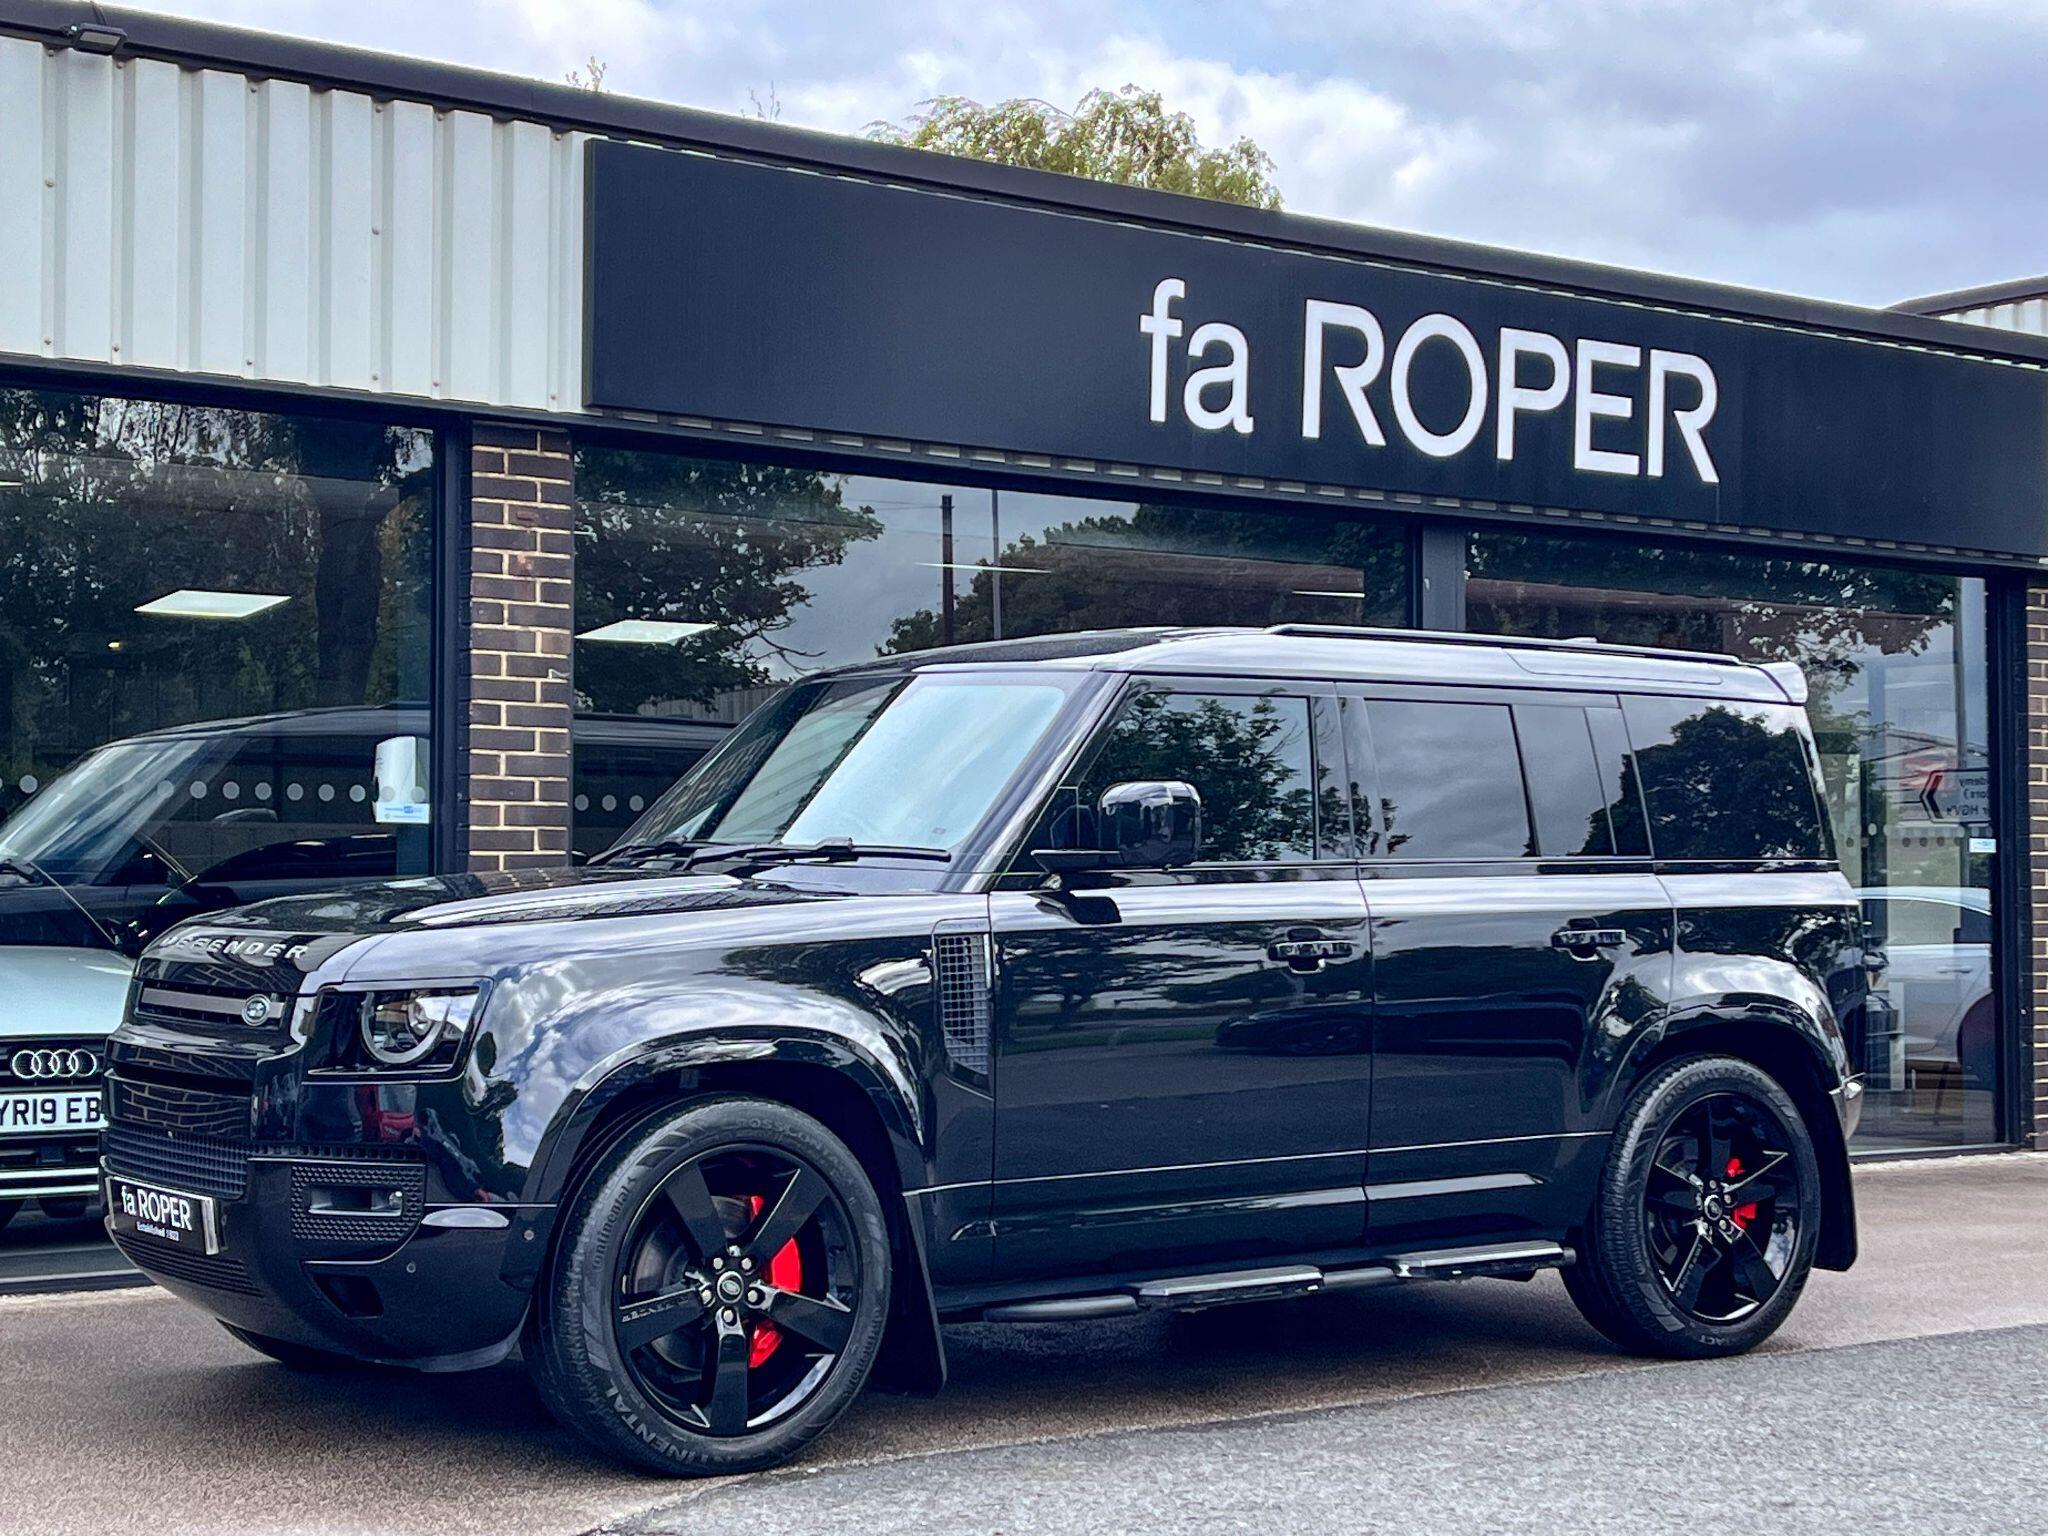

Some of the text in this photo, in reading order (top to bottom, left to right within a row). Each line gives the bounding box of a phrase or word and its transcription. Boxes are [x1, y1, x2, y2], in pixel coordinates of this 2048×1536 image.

[1139, 277, 1720, 485] fa ROPER
[160, 936, 309, 959] DEFENDER
[0, 1098, 57, 1126] YR19
[121, 1185, 193, 1231] fa ROPER
